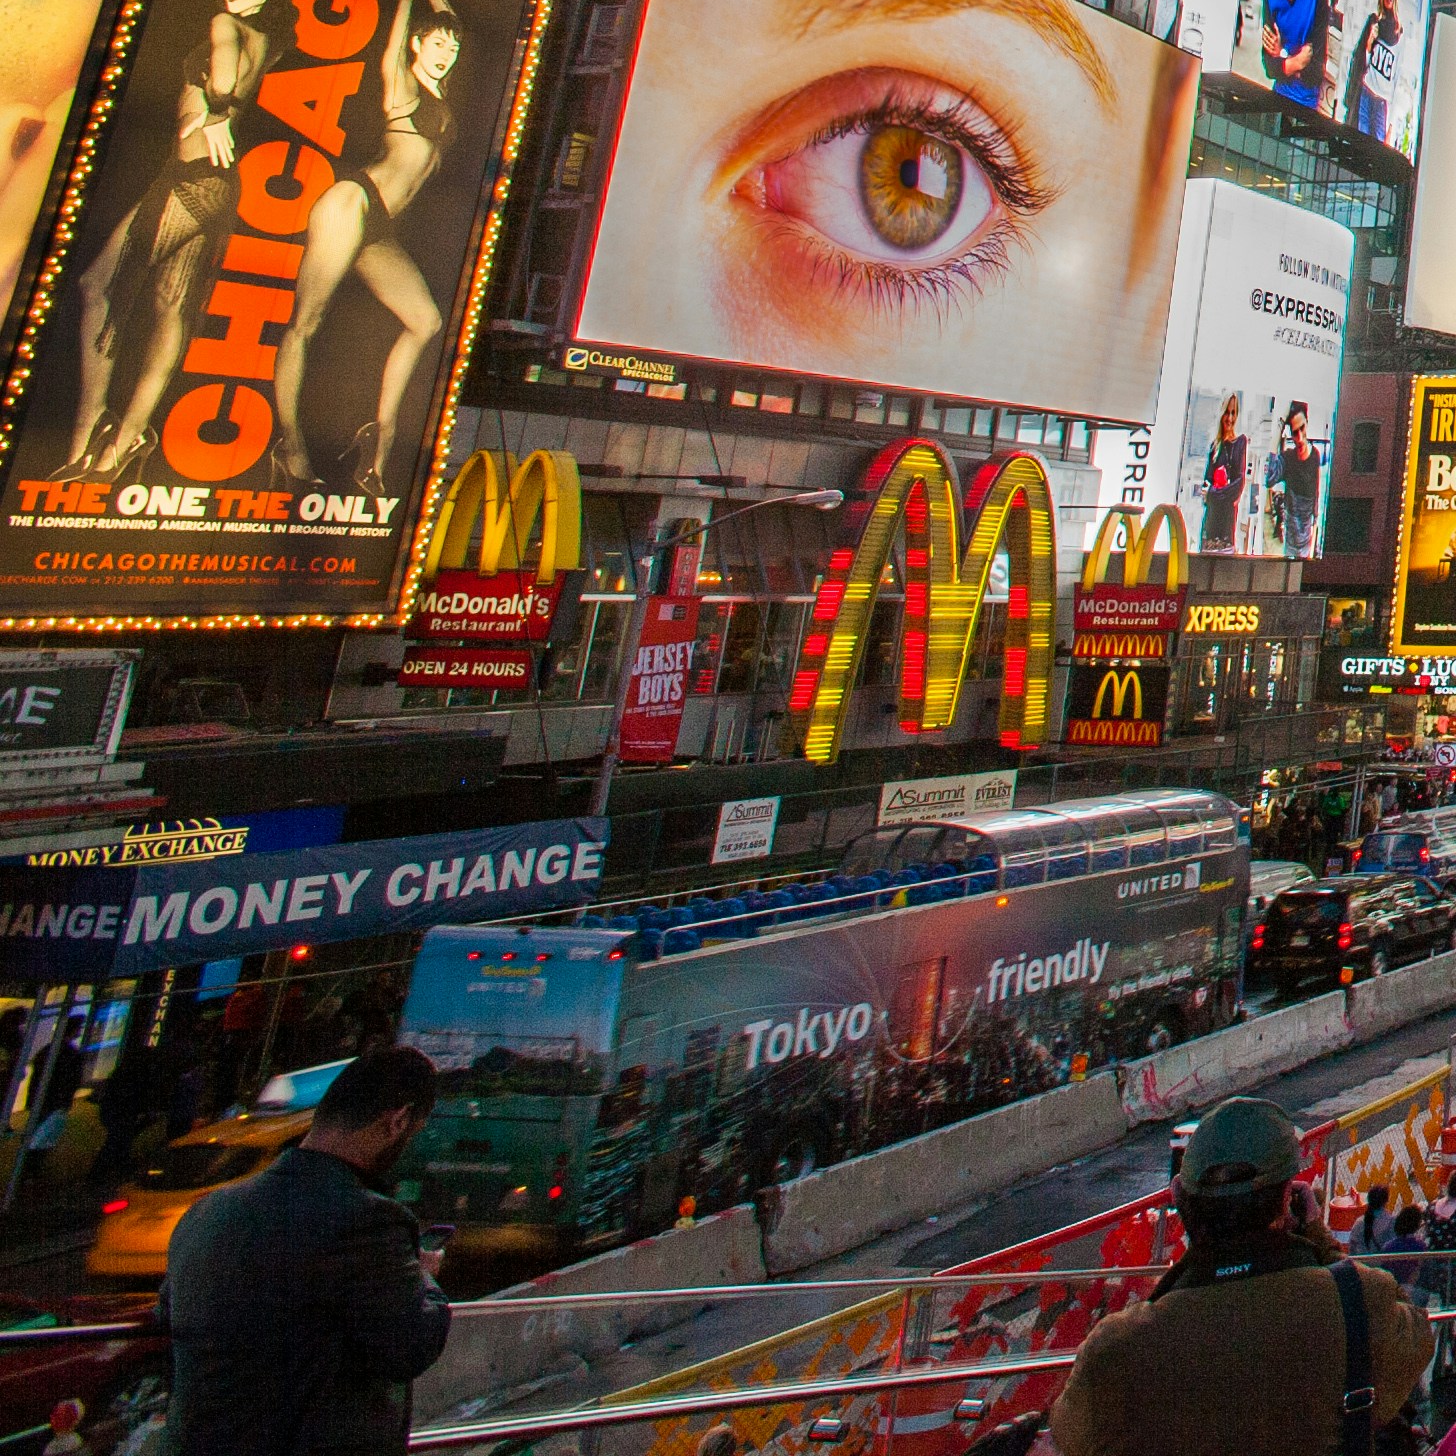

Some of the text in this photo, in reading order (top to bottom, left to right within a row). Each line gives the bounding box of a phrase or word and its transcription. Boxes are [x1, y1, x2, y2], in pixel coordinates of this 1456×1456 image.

[17, 480, 400, 524] THE ONE THE ONLY
[1426, 495, 1449, 510] The
[9, 515, 393, 537] THE LONGEST-RUNNING AMERICAN MUSICAL IN BROADWAY HISTORY
[34, 552, 356, 573] CHICAGOTHEMUSICAL.COM
[416, 592, 550, 616] McDonald's
[1078, 598, 1178, 614] McDonald's
[430, 617, 522, 633] Restaurant
[1092, 615, 1160, 626] Restaurant
[1185, 605, 1260, 633] XPRESS
[403, 661, 525, 677] OPEN 24 HOURS
[633, 641, 697, 675] JERSEY
[1341, 658, 1405, 676] GIFTS
[638, 672, 683, 706] BOYS
[904, 785, 966, 805] Summit
[26, 830, 247, 866] MONEY EXCHANGE
[123, 840, 607, 945] MONEY CHANGE
[1117, 873, 1182, 899] UNITED
[741, 937, 1110, 1070] Tokyo friendly
[1215, 1263, 1252, 1277] SONY
